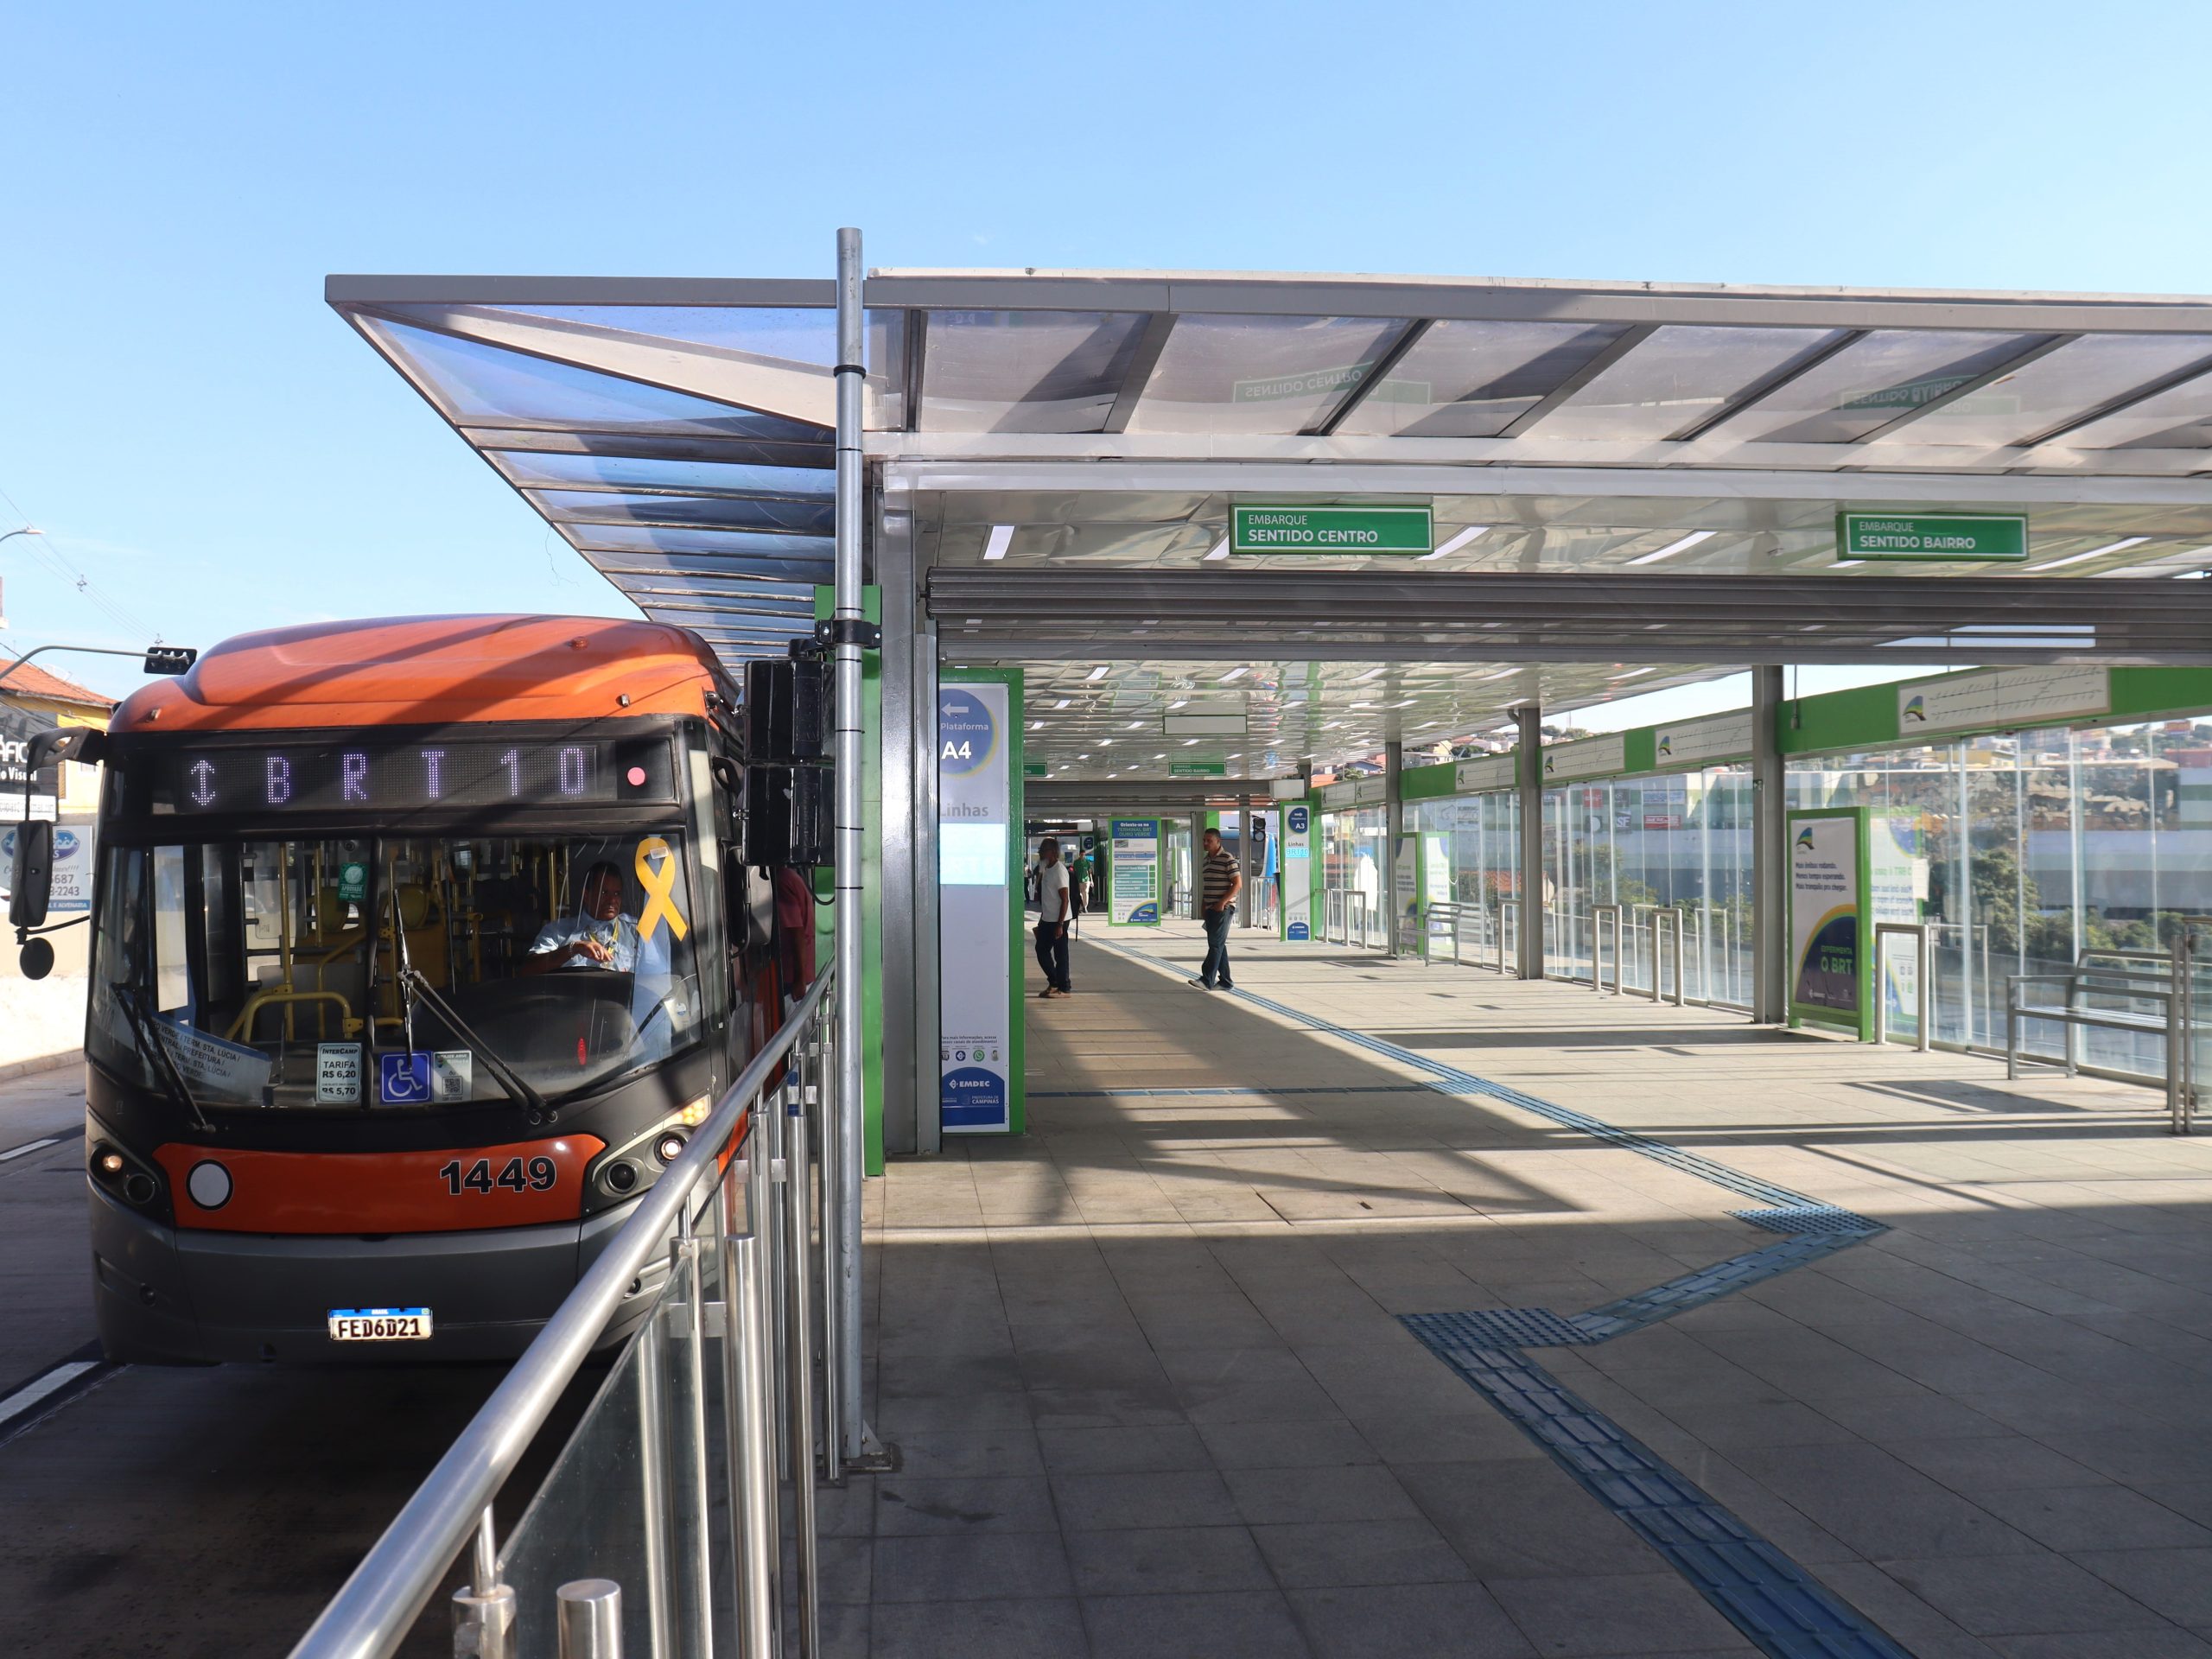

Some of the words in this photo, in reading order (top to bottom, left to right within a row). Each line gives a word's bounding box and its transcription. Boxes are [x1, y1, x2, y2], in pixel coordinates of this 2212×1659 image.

[1249, 514, 1308, 526] EMBARQUE
[1859, 521, 1914, 532] EMBARQUE
[1249, 529, 1313, 543] SENTIDO
[1318, 530, 1378, 543] CENTRO
[1859, 536, 1920, 549] SENTIDO
[1924, 537, 1976, 550] BAIRRO
[940, 721, 989, 731] Plataforma
[941, 741, 972, 760] A4
[1832, 957, 1853, 975] BRT
[337, 1071, 356, 1079] 6,20
[336, 1087, 356, 1096] 5,70
[440, 1156, 557, 1195] 1449
[338, 1319, 421, 1338] FED6D21
